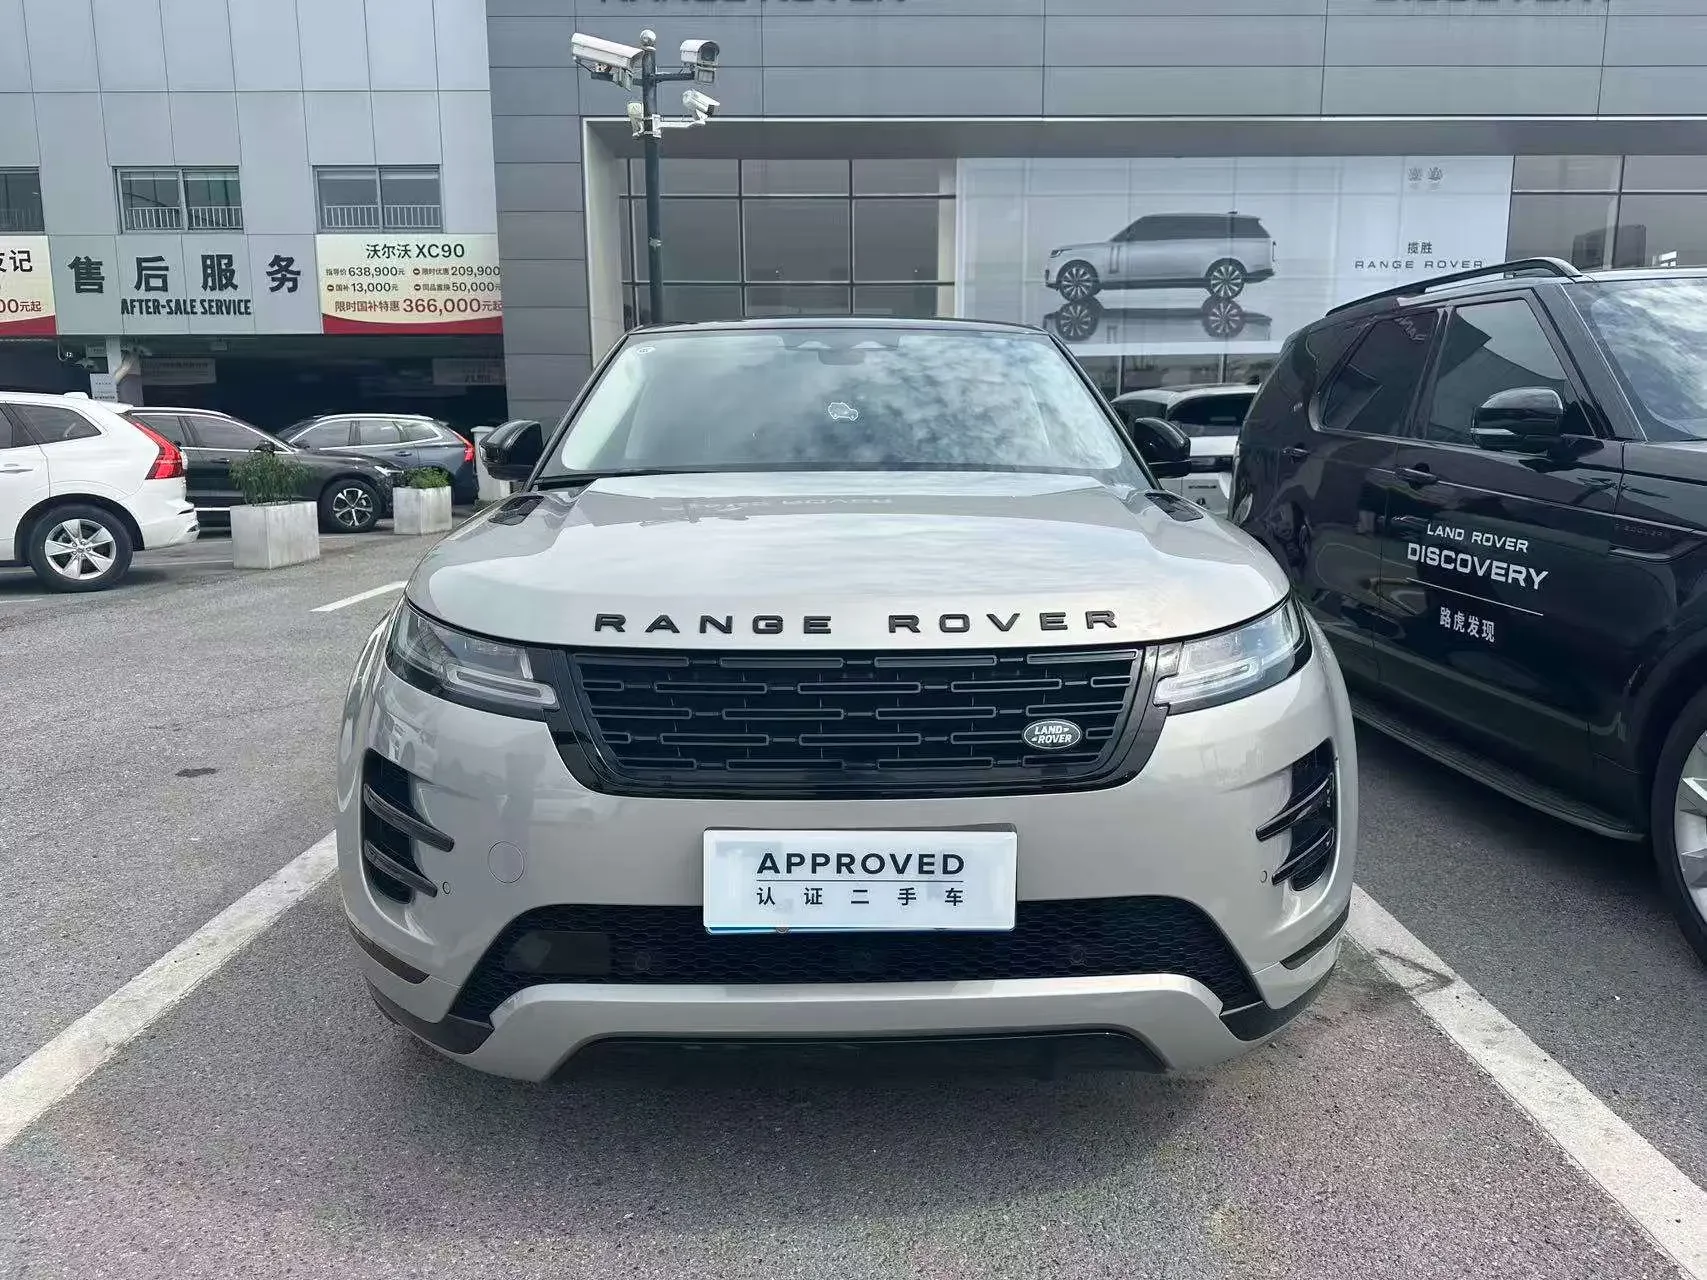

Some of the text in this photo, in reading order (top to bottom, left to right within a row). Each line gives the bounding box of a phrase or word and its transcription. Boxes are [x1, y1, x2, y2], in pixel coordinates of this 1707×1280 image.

[366, 243, 465, 259] 沃尔沃 XC90
[1407, 241, 1433, 254] 揽胜
[0, 249, 33, 272] 记
[1354, 260, 1484, 269] RANGE ROVER
[67, 254, 301, 293] 售后服务
[121, 298, 252, 316] AFTER-SALE SERVICE
[1427, 524, 1529, 553] LAND ROVER
[1407, 543, 1549, 590] DISCOVERY
[594, 609, 1119, 635] RANGE ROVER
[1439, 606, 1496, 643] 路虎发现
[1034, 725, 1063, 735] LAND
[1037, 733, 1073, 744] ROVER
[756, 852, 965, 875] APPROVED
[756, 887, 964, 906] 认证二手车
